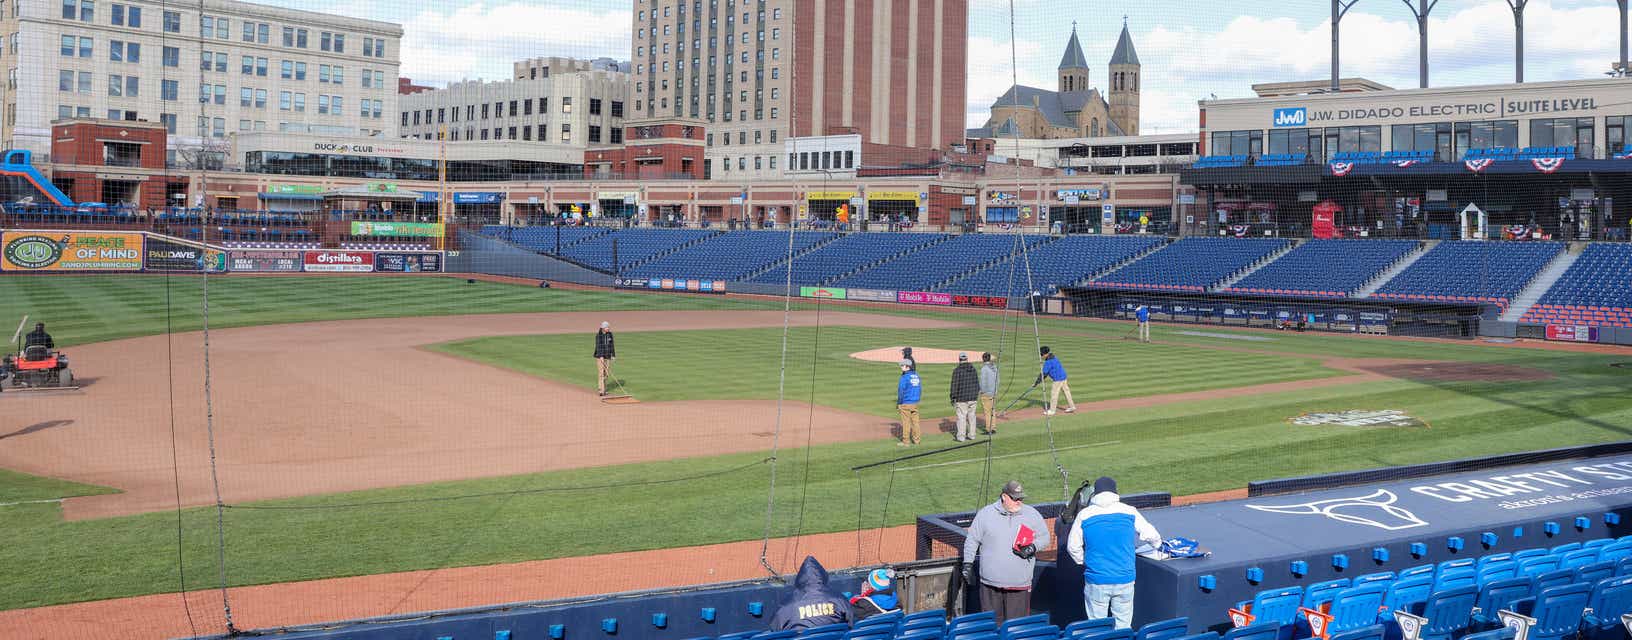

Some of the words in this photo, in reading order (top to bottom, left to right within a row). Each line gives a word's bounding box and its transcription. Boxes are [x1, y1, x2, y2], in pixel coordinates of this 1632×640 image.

[1308, 111, 1334, 121] J.W.
[1338, 107, 1404, 119] DIDADO
[1409, 103, 1496, 117] ELECTRIC
[1507, 101, 1549, 113] SUITE
[1552, 98, 1598, 112] LEVEL
[314, 143, 337, 151] DUCK
[76, 237, 125, 247] PEACE
[76, 249, 97, 259] OF
[100, 249, 138, 259] MIND
[1410, 470, 1592, 503] CRAFTY
[1572, 461, 1632, 480] ST
[799, 603, 834, 619] POLICE
